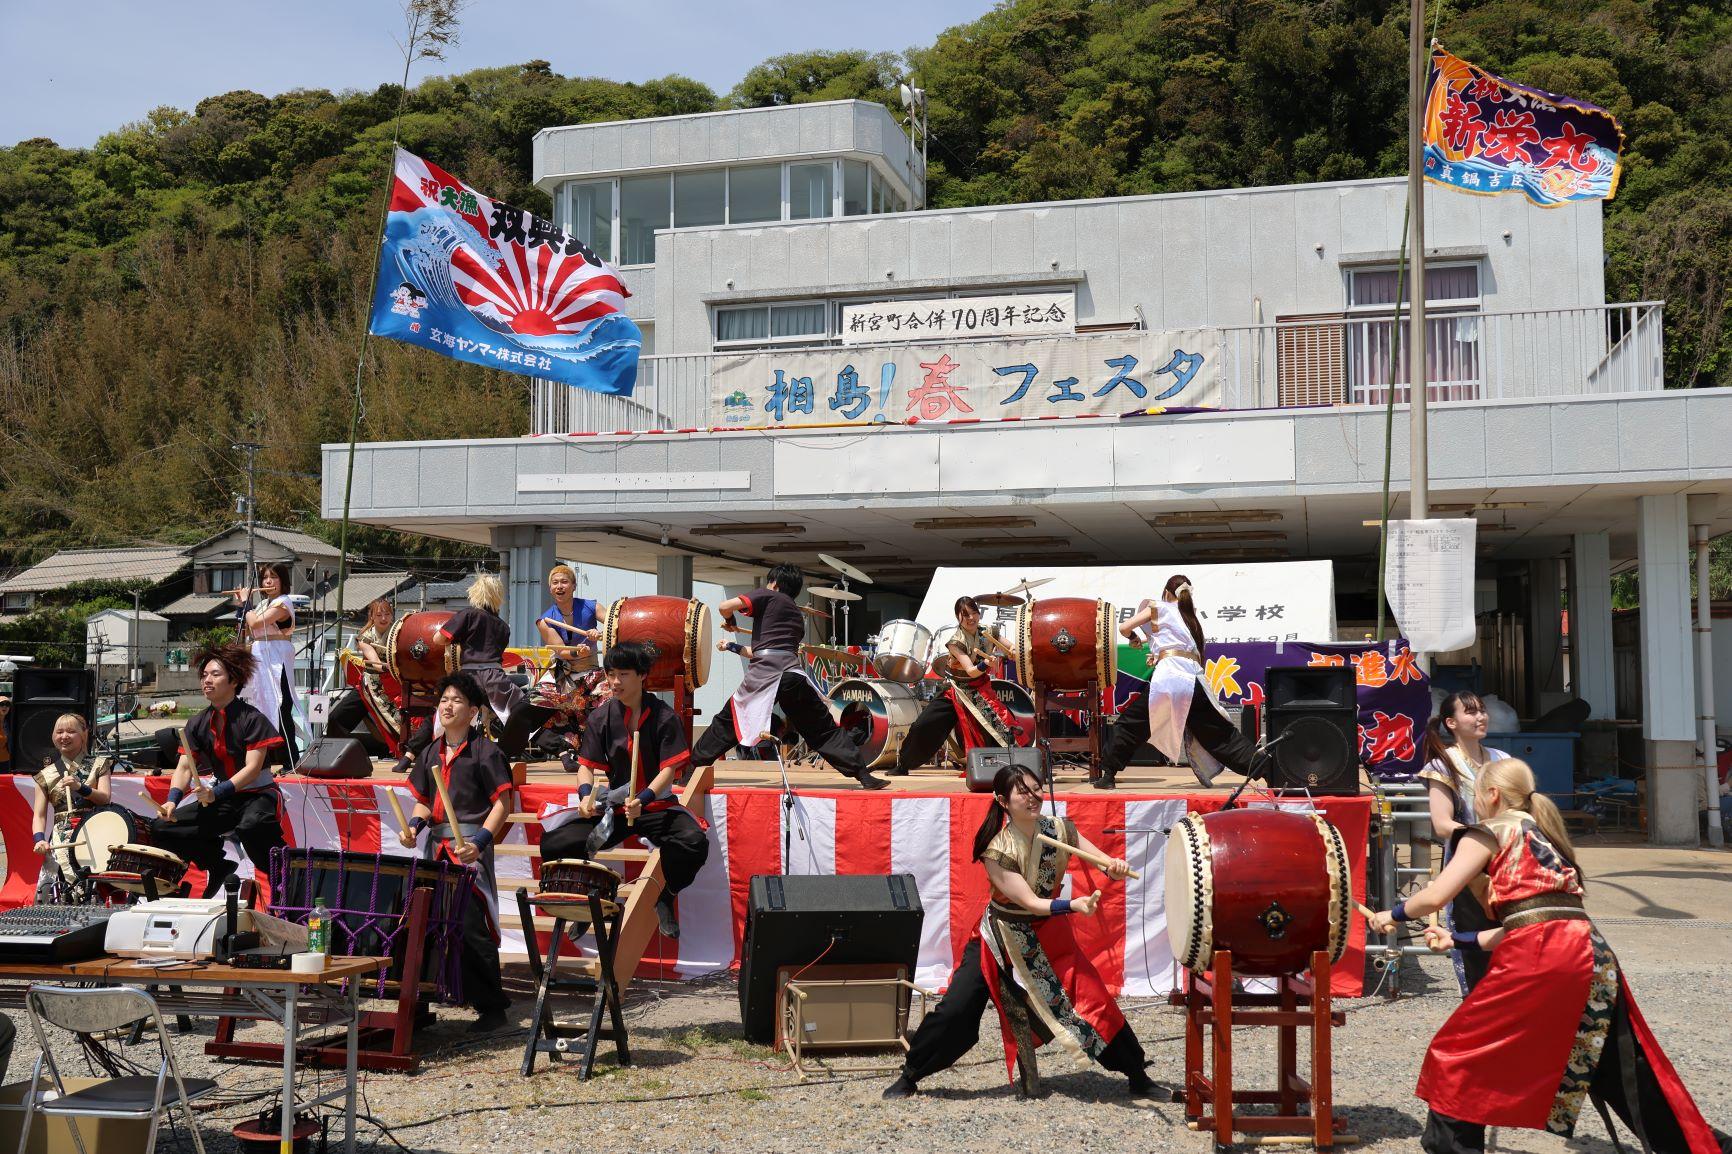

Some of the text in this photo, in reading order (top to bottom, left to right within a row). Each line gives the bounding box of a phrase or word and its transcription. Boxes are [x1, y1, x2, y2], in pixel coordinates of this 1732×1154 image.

[1438, 93, 1600, 173] 新栄丸
[849, 302, 1067, 333] 新宮町合併70周年記念
[429, 327, 552, 371] 玄海ヤンマー株式会社
[314, 703, 324, 714] 4
[842, 689, 873, 702] YAMAHA
